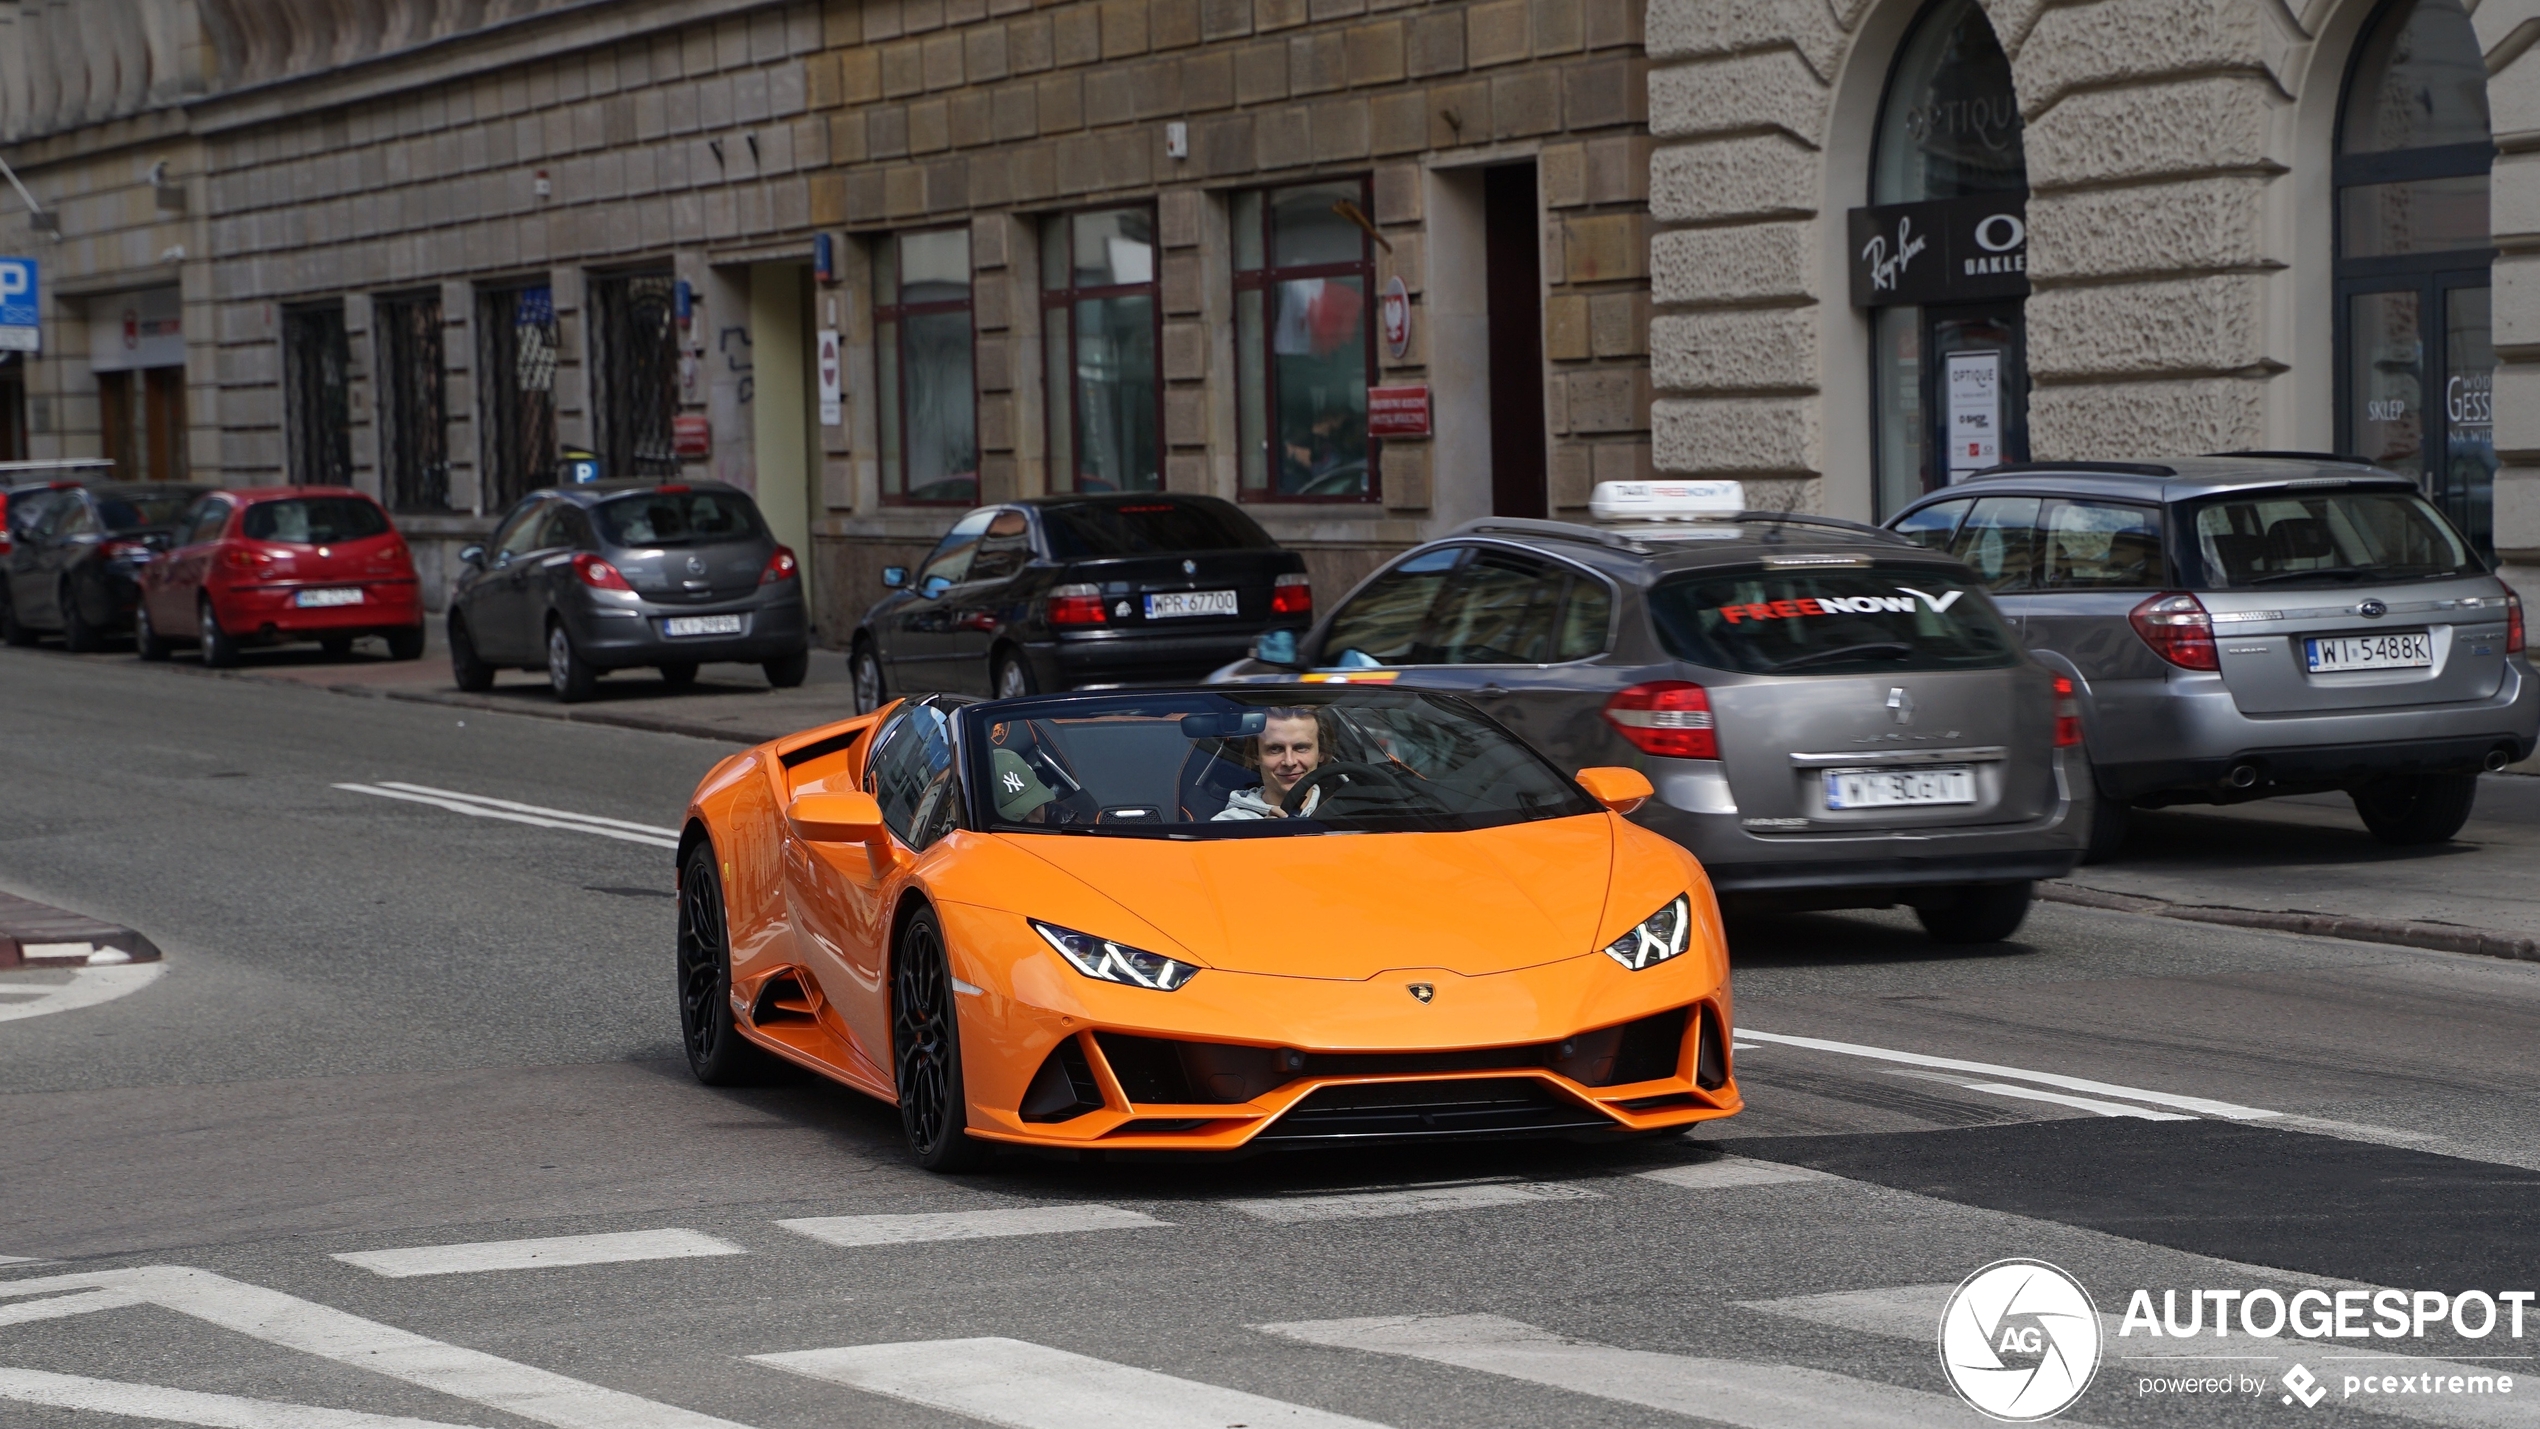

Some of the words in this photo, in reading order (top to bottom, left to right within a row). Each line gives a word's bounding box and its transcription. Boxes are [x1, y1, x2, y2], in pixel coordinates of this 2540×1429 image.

[0, 263, 27, 306] P
[2368, 400, 2405, 421] SKLEP
[576, 463, 593, 485] P
[1153, 596, 1183, 612] WPR
[1189, 593, 1234, 611] 67700
[2321, 640, 2349, 663] WI
[2360, 635, 2427, 661] 5488K
